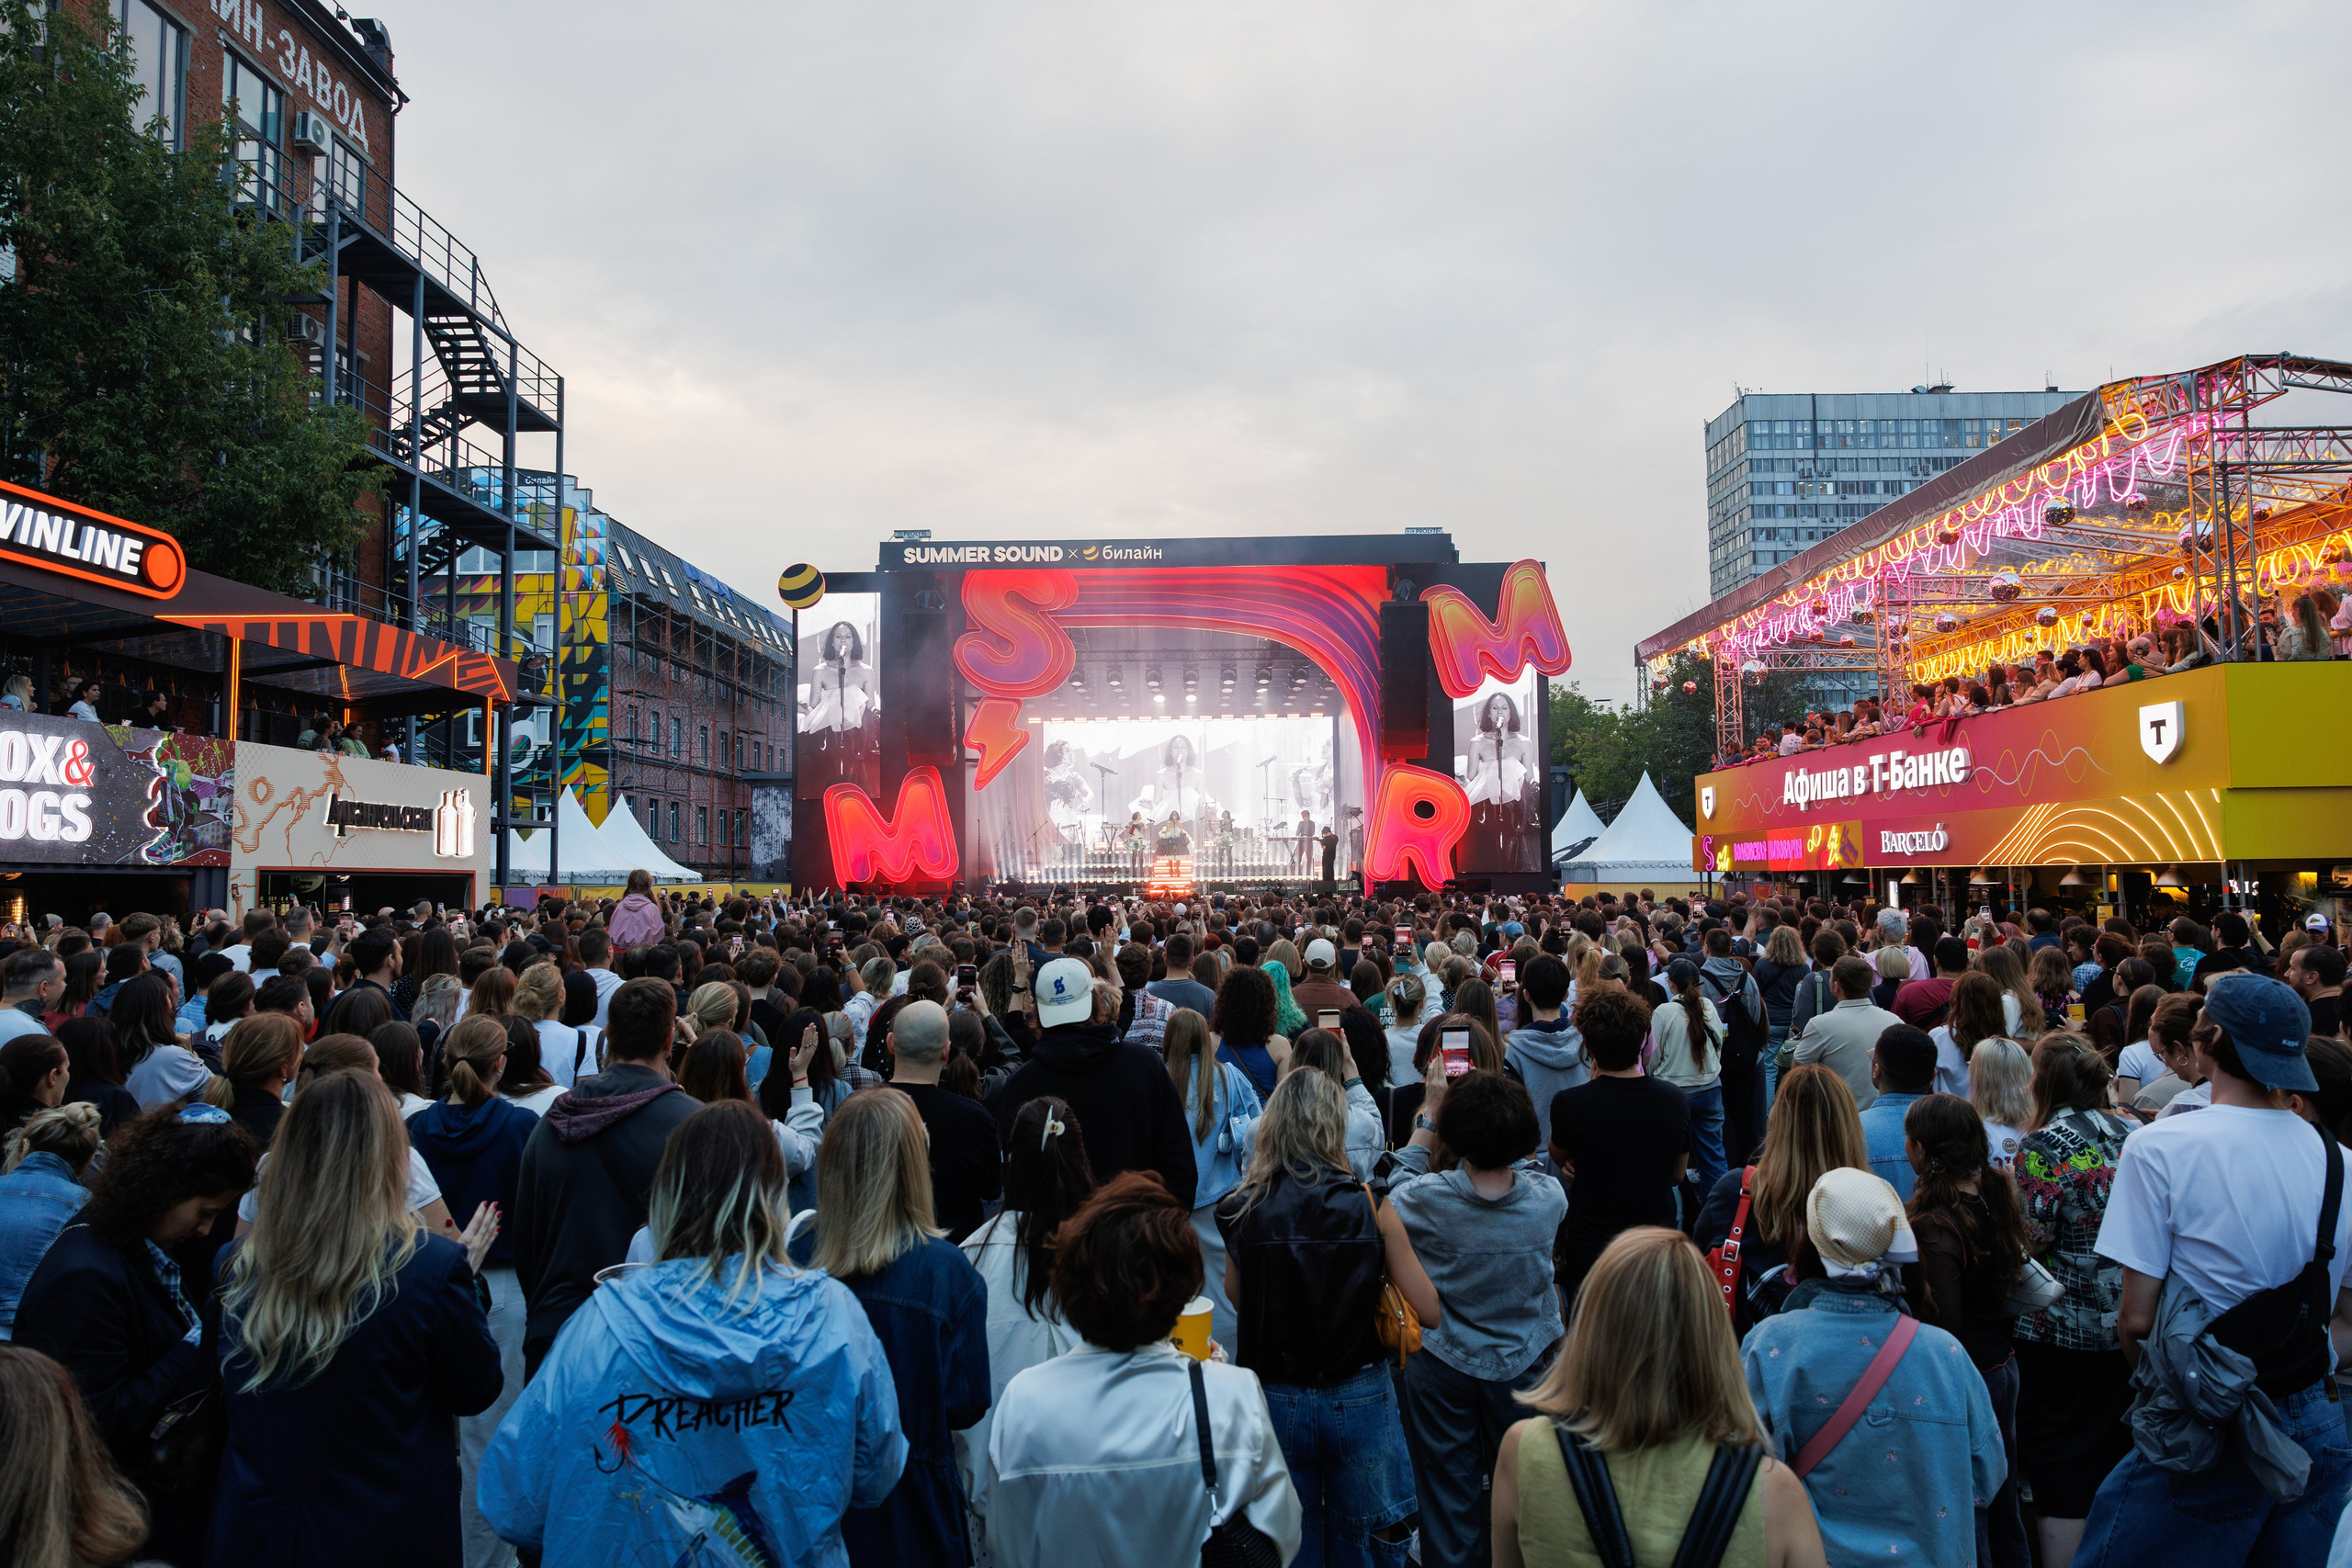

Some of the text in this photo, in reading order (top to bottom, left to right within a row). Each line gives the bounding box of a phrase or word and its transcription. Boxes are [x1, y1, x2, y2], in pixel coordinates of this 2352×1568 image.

[210, 0, 369, 154] ИН-ЗАВОД
[904, 546, 991, 564] SUMMER
[993, 545, 1064, 563] SOUND
[1102, 545, 1163, 560] билайн
[1783, 747, 1972, 811] Афиша в Т-Банке
[1880, 822, 1949, 856] BARCELÓ
[598, 1390, 795, 1443] PREACHER
